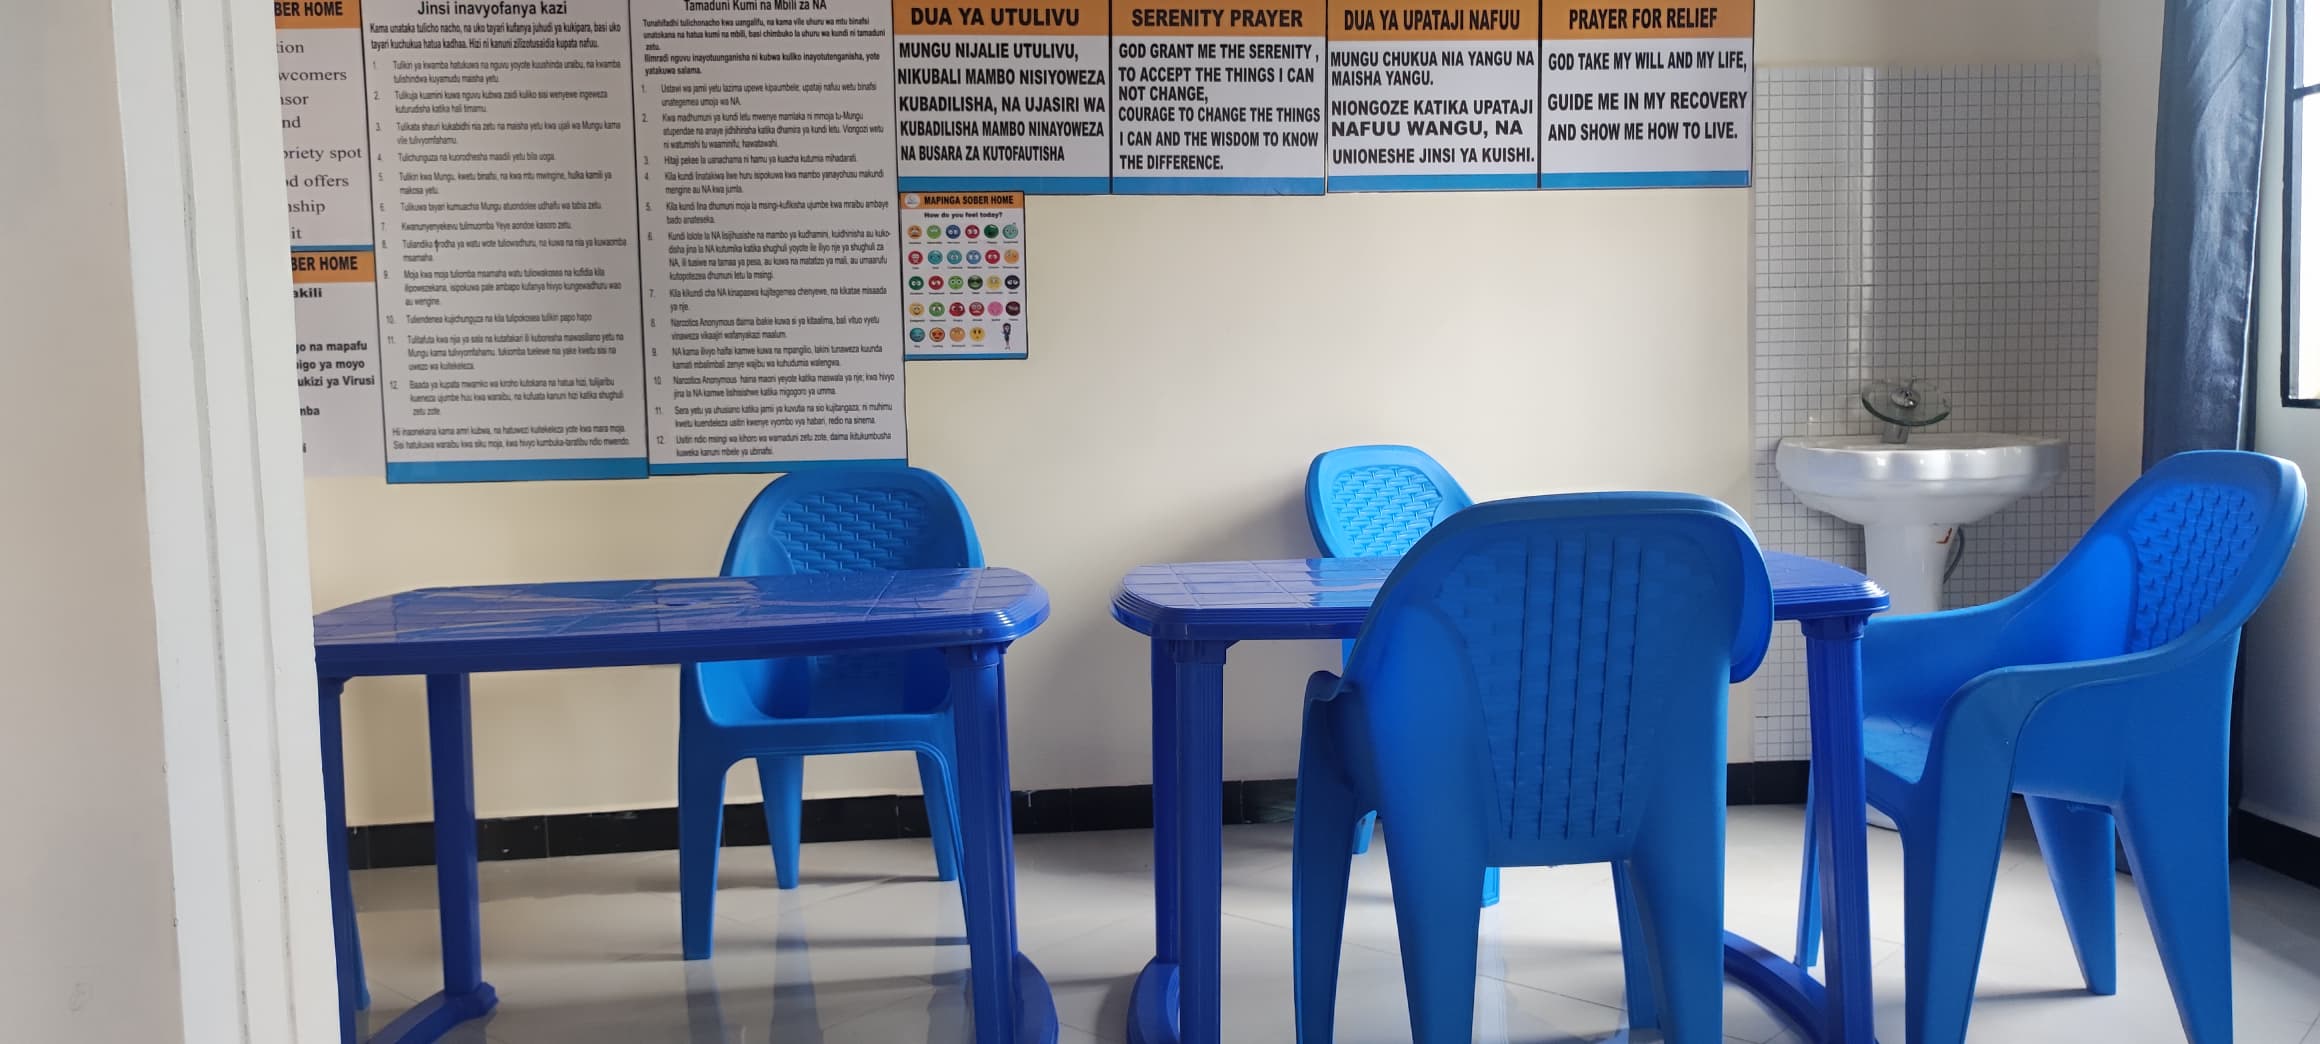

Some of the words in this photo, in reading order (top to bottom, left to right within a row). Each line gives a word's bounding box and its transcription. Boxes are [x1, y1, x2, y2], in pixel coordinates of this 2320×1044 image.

[304, 1, 343, 16] HOME
[417, 1, 450, 14] Jinsi
[454, 0, 536, 17] inavyofanya
[540, 0, 567, 14] kazi
[683, 0, 730, 11] Tamaduni
[732, 0, 757, 10] Kumi
[760, 1, 771, 10] na
[774, 0, 796, 10] Mbili
[799, 0, 810, 10] za
[812, 0, 827, 9] NA
[911, 7, 952, 25] DUA
[958, 7, 984, 25] YA
[991, 7, 1079, 26] UTULIVU
[1132, 8, 1224, 26] SERENITY
[1230, 9, 1302, 27] PRAYER
[1344, 9, 1375, 30] DUA
[1379, 9, 1398, 30] YA
[1403, 9, 1463, 30] UPATAJI
[1469, 9, 1520, 30] NAFUU
[1569, 8, 1627, 29] PRAYER
[1632, 8, 1661, 28] FOR
[1666, 7, 1717, 28] RELIEF
[423, 39, 441, 48] hatua
[483, 39, 489, 48] ni
[557, 39, 578, 50] kupata
[899, 42, 950, 58] MUNGU
[955, 42, 1009, 58] NIJALIE
[1013, 43, 1078, 62] UTULIVU,
[1118, 43, 1146, 58] GOD
[1149, 43, 1194, 58] GRANT
[1197, 43, 1216, 58] ME
[1219, 43, 1245, 58] THE
[1249, 43, 1311, 59] SERENITY
[751, 52, 758, 61] ni
[1330, 51, 1378, 67] MUNGU
[1382, 51, 1437, 66] CHUKUA
[1441, 51, 1464, 66] NIA
[1468, 51, 1512, 66] YANGU
[1516, 50, 1534, 65] NA
[1548, 53, 1574, 70] GOD
[1577, 52, 1609, 70] TAKE
[1613, 52, 1631, 69] MY
[1635, 51, 1664, 69] WILL
[1667, 51, 1693, 68] AND
[1696, 51, 1714, 68] MY
[1718, 50, 1746, 71] LIFE,
[897, 68, 961, 84] NIKUBALI
[965, 68, 1015, 84] MAMBO
[1019, 69, 1105, 85] NISIYOWEZA
[1117, 66, 1136, 82] TO
[1139, 66, 1191, 82] ACCEPT
[1195, 67, 1221, 82] THE
[1224, 67, 1274, 82] THINGS
[1279, 67, 1282, 82] I
[1287, 67, 1313, 82] CAN
[1331, 70, 1381, 86] MAISHA
[1385, 70, 1433, 85] YANGU.
[1118, 85, 1145, 100] NOT
[1149, 86, 1208, 104] CHANGE,
[1547, 93, 1593, 111] GUIDE
[1598, 92, 1618, 110] ME
[1624, 92, 1638, 110] IN
[1644, 91, 1665, 109] MY
[1670, 91, 1747, 109] RECOVERY
[899, 96, 997, 115] KUBADILISHA,
[1001, 96, 1021, 111] NA
[1025, 96, 1079, 112] UJASIRI
[1083, 97, 1105, 112] WA
[1331, 99, 1409, 116] NIONGOZE
[1413, 99, 1468, 115] KATIKA
[1473, 99, 1532, 114] UPATAJI
[1118, 106, 1175, 121] COURAGE
[1178, 106, 1194, 121] TO
[1197, 106, 1246, 122] CHANGE
[1249, 107, 1272, 122] THE
[1275, 107, 1320, 122] THINGS
[900, 120, 978, 136] KUBADILISHA
[982, 120, 1025, 136] MAMBO
[1028, 121, 1104, 136] NINAYOWEZA
[1331, 120, 1400, 136] NAFUU
[1406, 120, 1488, 138] WANGU,
[1495, 119, 1523, 135] NA
[1548, 123, 1576, 141] AND
[1580, 122, 1620, 140] SHOW
[1624, 122, 1643, 140] ME
[1647, 121, 1679, 140] HOW
[1682, 121, 1700, 139] TO
[1704, 121, 1737, 139] LIVE.
[1119, 131, 1123, 146] I
[1127, 130, 1151, 146] CAN
[1155, 131, 1180, 146] AND
[1183, 131, 1207, 146] THE
[1210, 131, 1259, 146] WISDOM
[1262, 131, 1278, 146] TO
[1282, 131, 1318, 146] KNOW
[330, 148, 362, 161] spot
[900, 145, 916, 160] NA
[918, 145, 962, 160] BUSARA
[965, 145, 980, 161] ZA
[982, 145, 1064, 161] KUTOFAUTISHA
[1332, 148, 1414, 164] UNIONESHE
[1419, 147, 1455, 163] JINSI
[1460, 147, 1477, 162] YA
[1482, 147, 1534, 162] KUISHI.
[1119, 154, 1143, 169] THE
[1147, 154, 1223, 169] DIFFERENCE.
[304, 174, 349, 187] offers
[924, 196, 960, 204] MAPINGA
[962, 195, 988, 204] SOBER
[990, 195, 1013, 204] HOME
[979, 211, 1002, 219] today?
[291, 226, 302, 239] it
[320, 256, 358, 270] HOME
[310, 343, 323, 351] na
[327, 341, 367, 353] mapafu
[320, 361, 332, 371] ya
[336, 360, 365, 371] moyo
[327, 378, 339, 389] ya
[342, 375, 375, 386] Virusi
